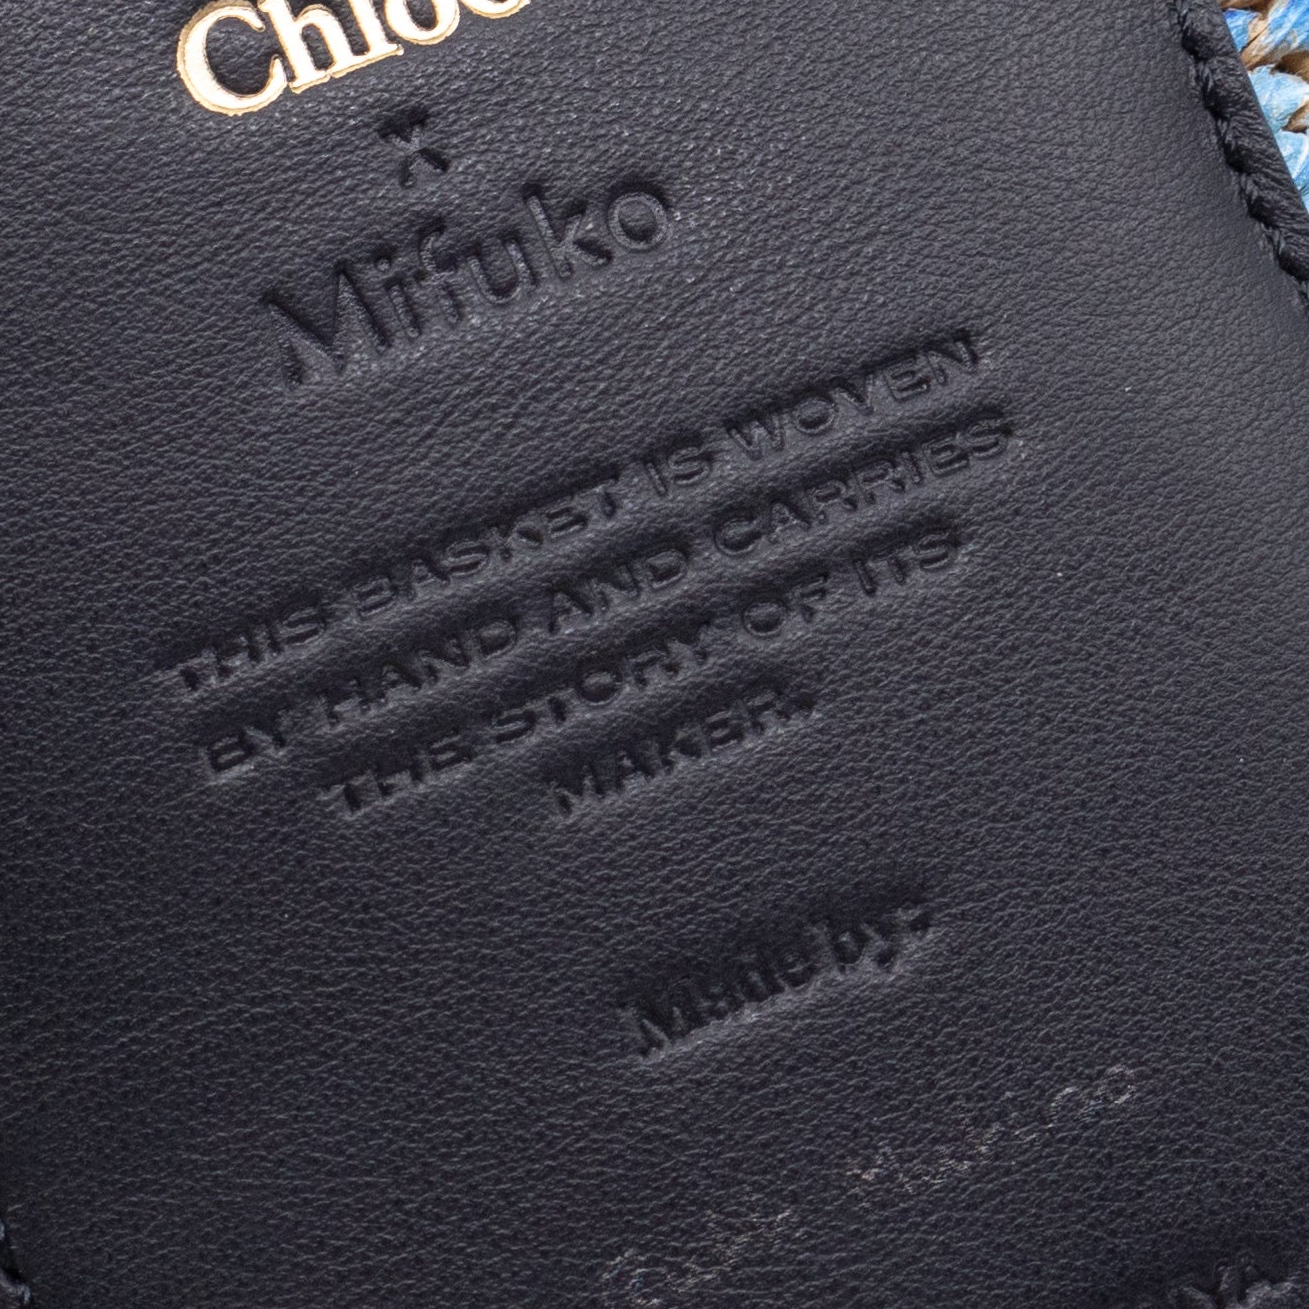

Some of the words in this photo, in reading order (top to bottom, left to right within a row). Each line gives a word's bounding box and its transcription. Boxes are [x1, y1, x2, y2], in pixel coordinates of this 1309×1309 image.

[262, 181, 676, 386] Mifuko
[175, 609, 329, 693] THIS
[351, 480, 621, 616] BASKET
[646, 443, 711, 496] IS
[723, 328, 978, 461] WOVEN
[206, 703, 294, 773] BY
[323, 616, 519, 728] HAND
[548, 549, 689, 634] AND
[713, 413, 1011, 556] CARRIES
[326, 738, 476, 813] THE
[491, 619, 713, 746] STORY
[741, 571, 829, 637] OF
[849, 528, 956, 596] ITS
[631, 933, 821, 1057] Made
